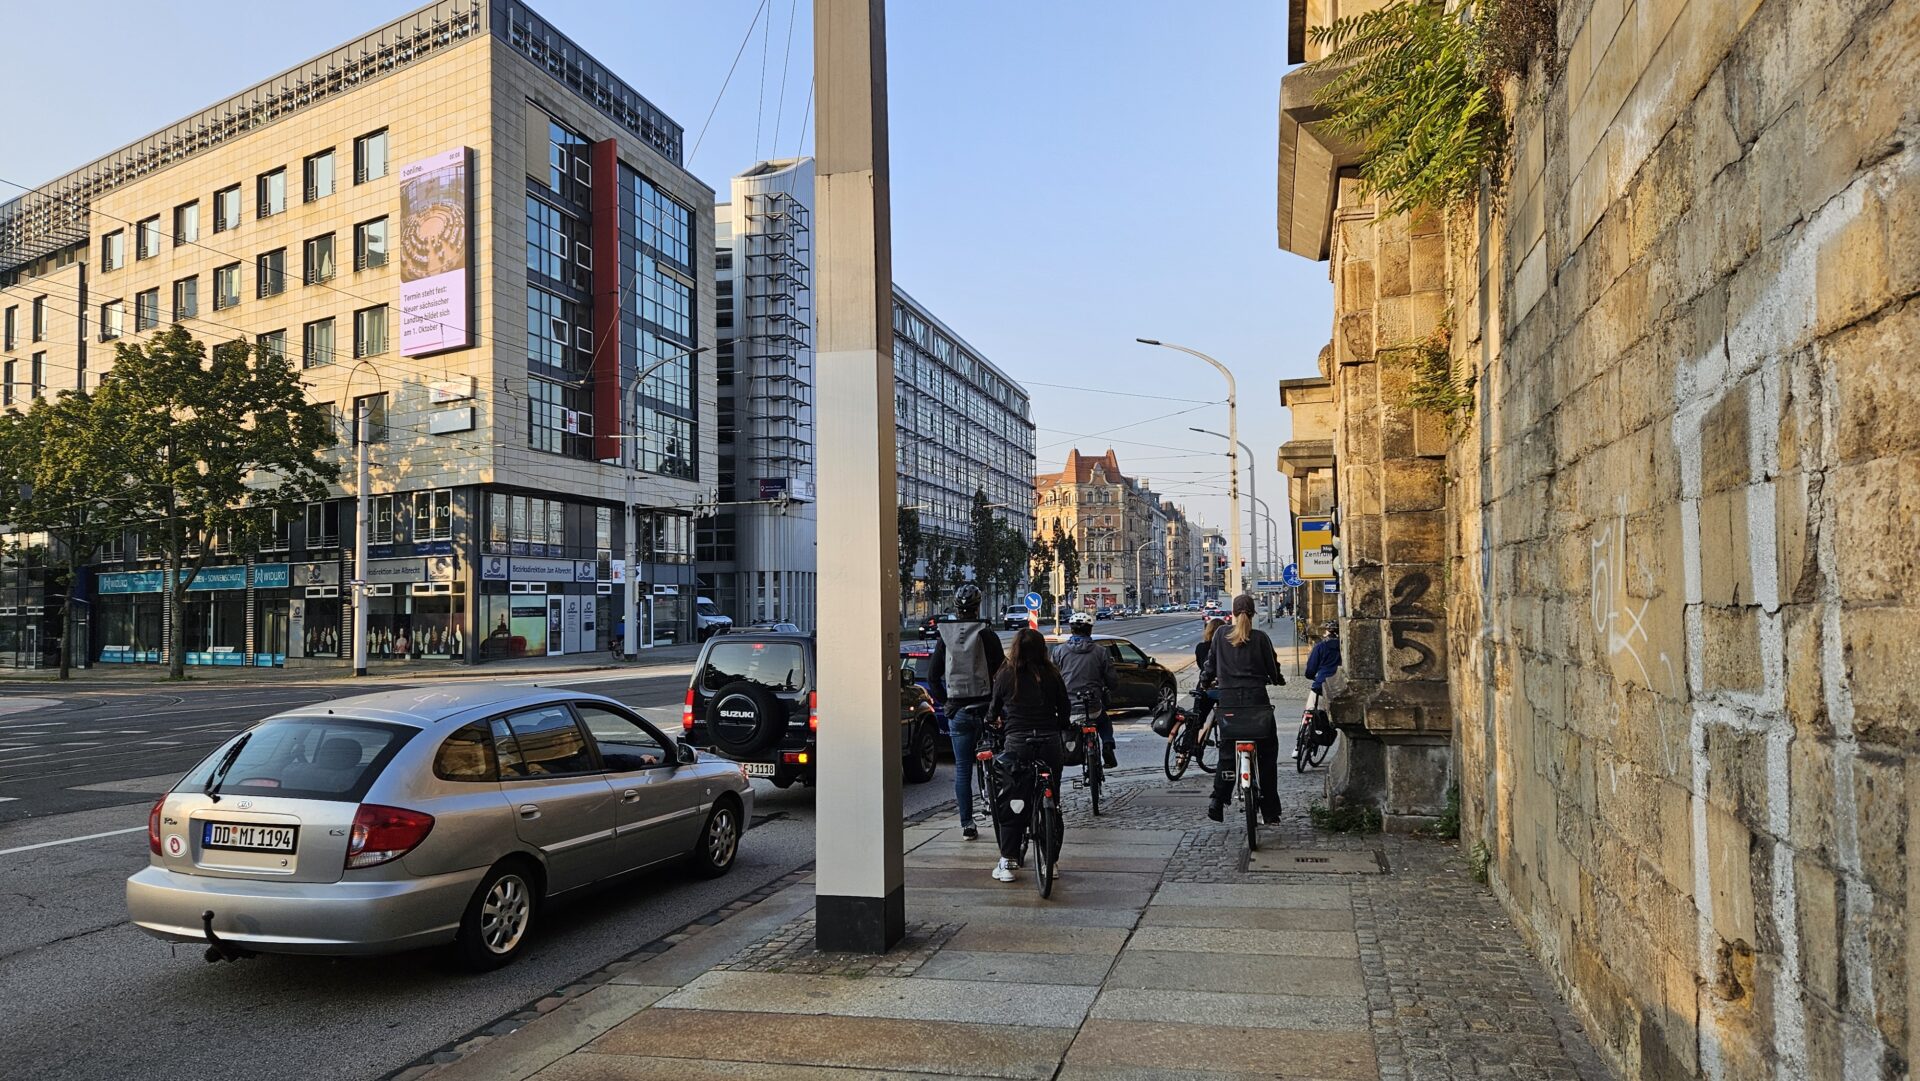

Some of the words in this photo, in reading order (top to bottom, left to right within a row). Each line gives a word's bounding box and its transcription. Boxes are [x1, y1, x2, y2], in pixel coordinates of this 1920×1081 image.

[404, 291, 420, 302] Termin
[422, 288, 435, 298] steht
[435, 286, 447, 295] fest:
[404, 305, 419, 313] Neuer
[420, 298, 449, 310] sächsischer
[404, 315, 423, 325] Landtag
[424, 311, 439, 320] bildet
[440, 308, 450, 317] sich
[419, 324, 438, 333] Oktober
[401, 566, 421, 574] Albrecht
[512, 565, 546, 573] Bezirksdirektion
[555, 566, 572, 574] Albrecht
[207, 573, 240, 582] SONNENSCHUTZ
[264, 571, 285, 581] WIDURO
[720, 710, 755, 718] SUZUKI
[755, 764, 774, 774] 1118
[213, 826, 230, 844] DD
[239, 828, 255, 846] MI
[257, 829, 291, 847] 1194
